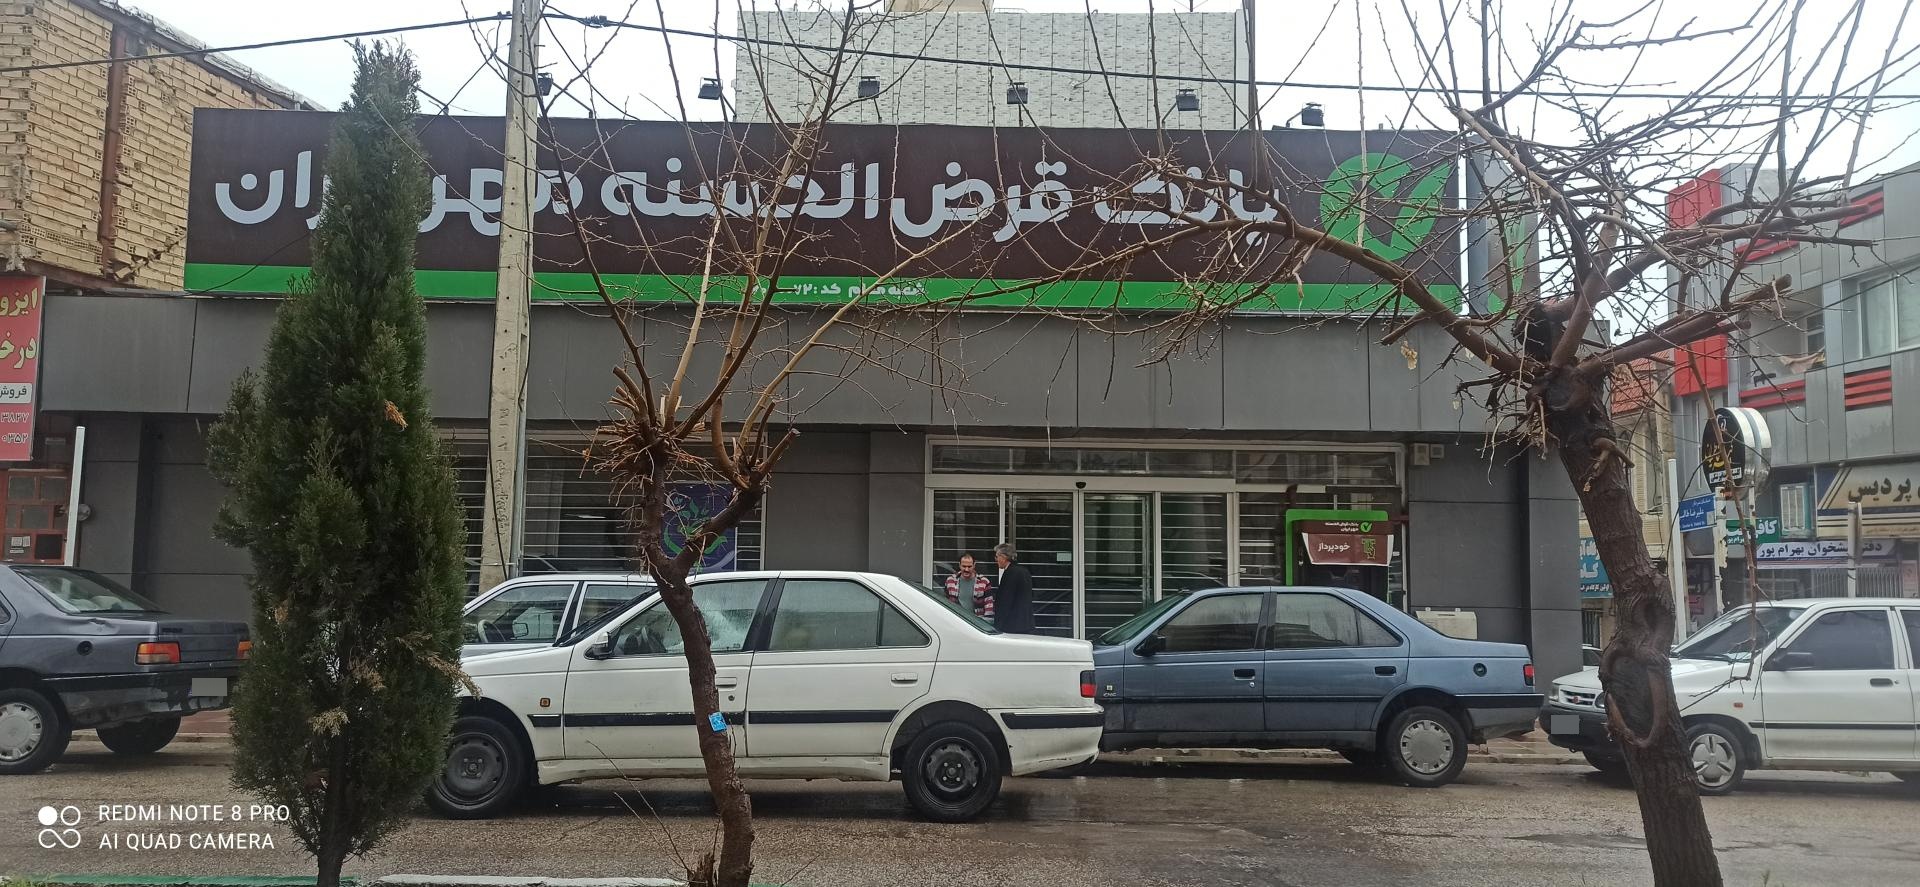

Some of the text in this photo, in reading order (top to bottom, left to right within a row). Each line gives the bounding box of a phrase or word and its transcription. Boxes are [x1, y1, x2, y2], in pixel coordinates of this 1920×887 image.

[600, 157, 880, 220] الحسنه
[891, 161, 1073, 243] قرض
[1093, 166, 1281, 247] بانک
[1848, 477, 1912, 503] پردیس
[1318, 542, 1350, 554] خودپرداز
